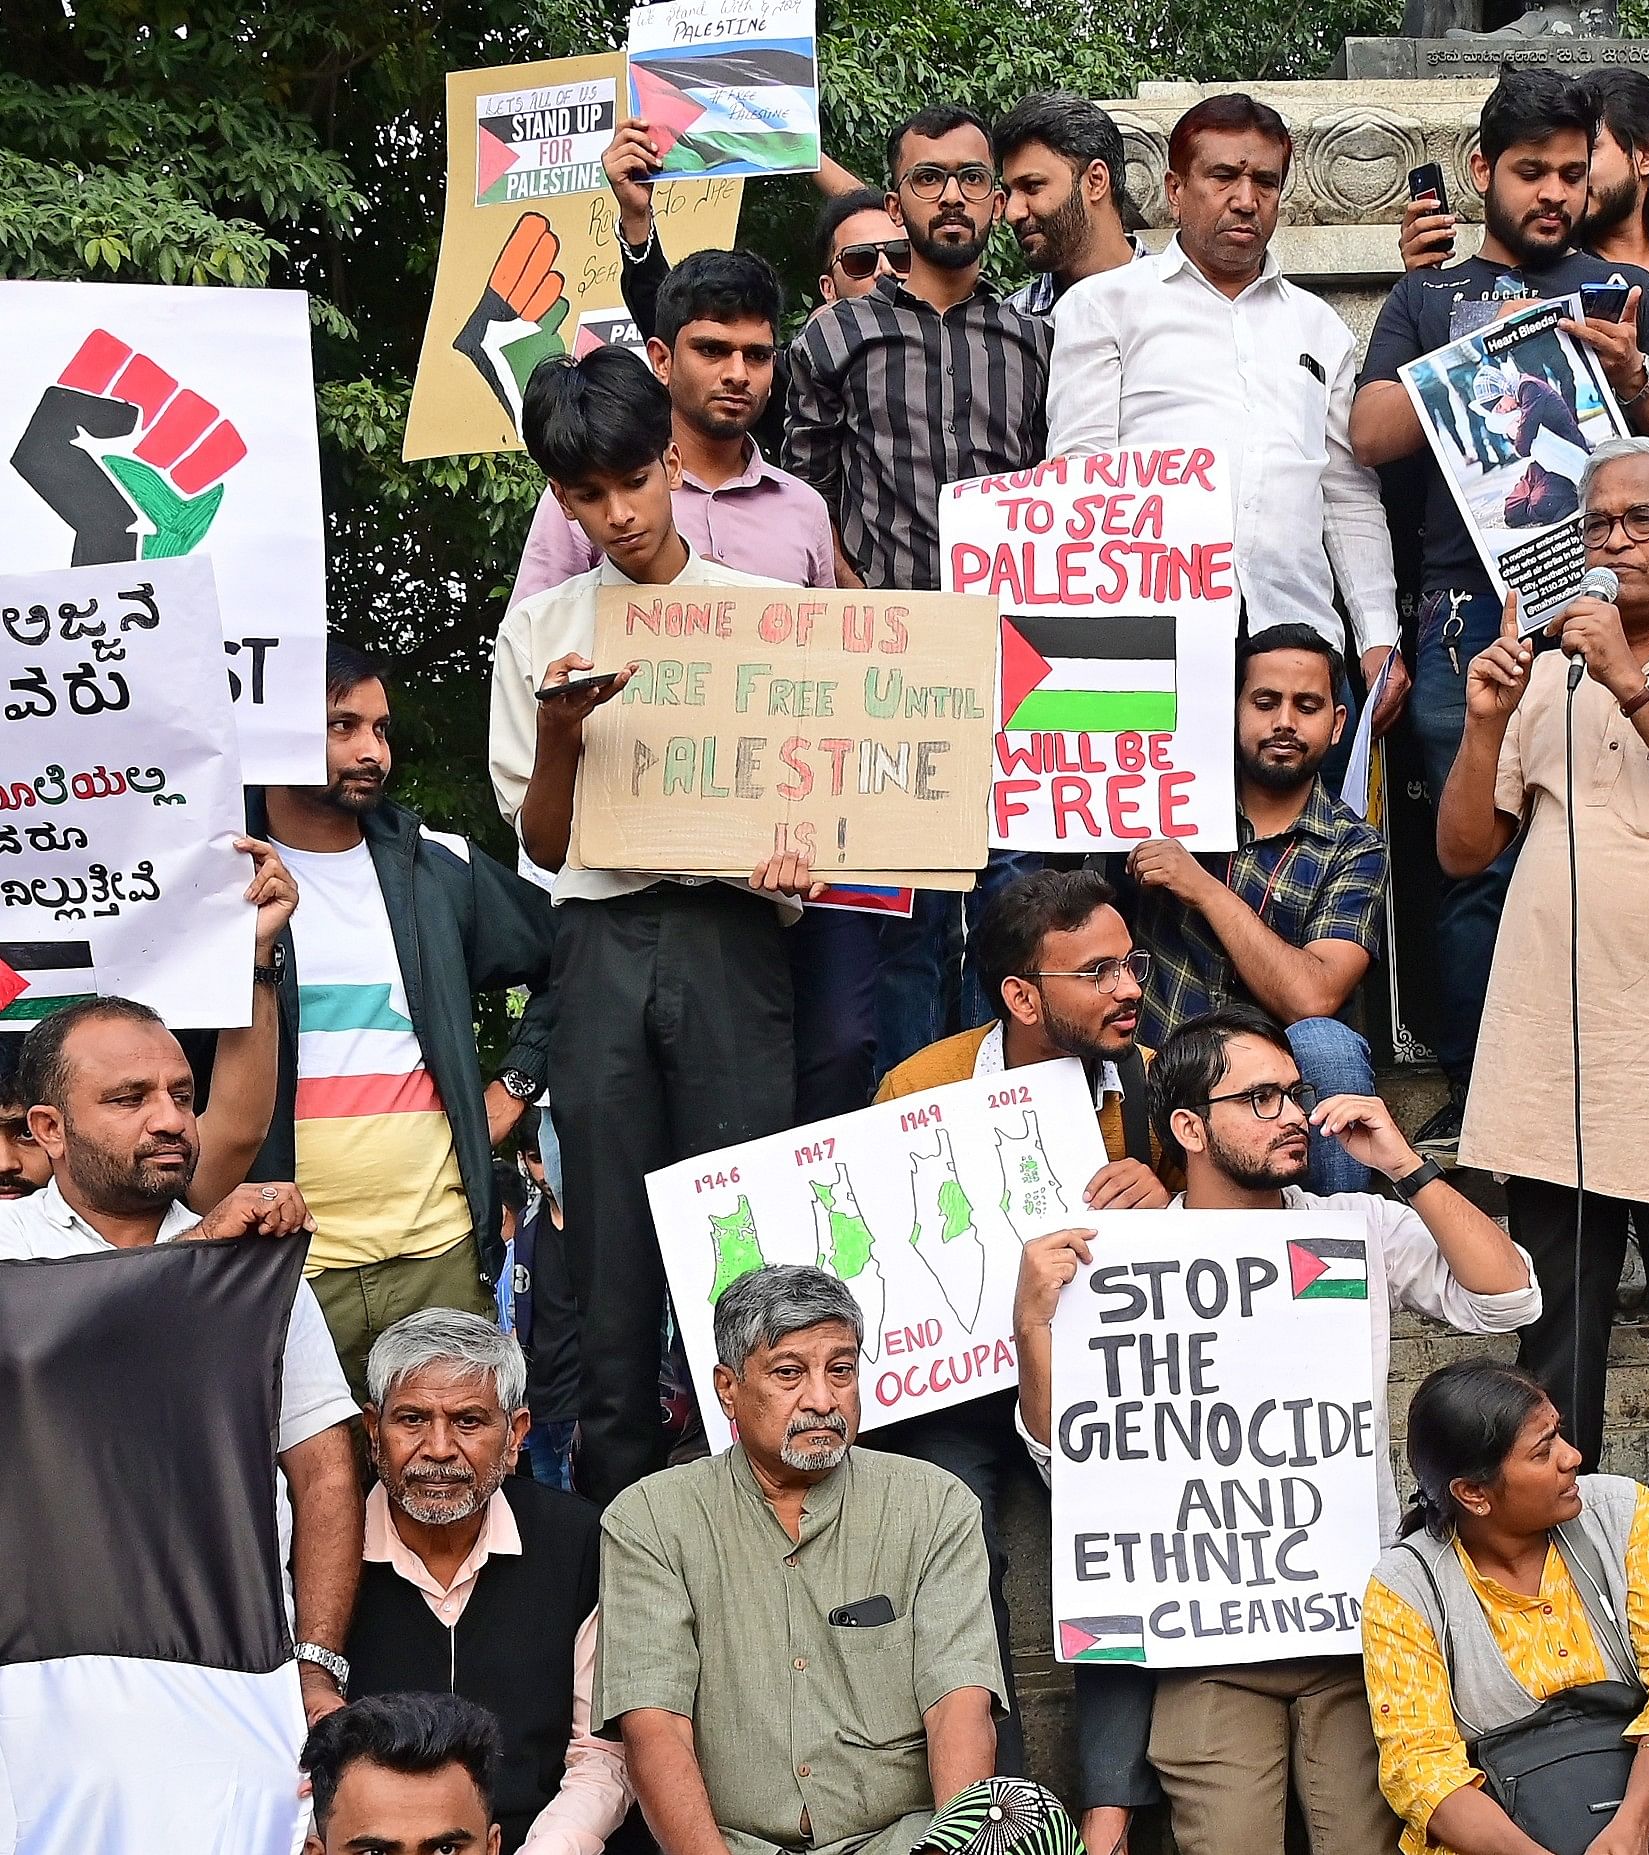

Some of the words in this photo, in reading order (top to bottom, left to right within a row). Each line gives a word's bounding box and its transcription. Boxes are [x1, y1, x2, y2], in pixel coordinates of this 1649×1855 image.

[673, 18, 767, 43] PALESTINE
[530, 91, 551, 110] ALL
[556, 89, 573, 105] OF
[579, 85, 597, 102] US
[727, 107, 789, 120] PALESTINE
[511, 108, 570, 142] STAND
[577, 104, 602, 133] UP
[539, 138, 573, 166] FOR
[506, 163, 601, 200] PALESTINE
[578, 255, 619, 298] SEA
[1487, 330, 1519, 353] Heart
[1518, 312, 1557, 338] Bleeds!
[953, 457, 1068, 499] FROM
[1084, 447, 1216, 492] RIVER
[995, 496, 1055, 535] TO
[1065, 494, 1164, 539] SEA
[1502, 557, 1509, 566] A
[1509, 545, 1535, 563] mother
[1536, 528, 1570, 549] embraces
[1502, 563, 1520, 577] child
[1521, 557, 1537, 568] who
[1537, 549, 1552, 561] was
[1551, 539, 1571, 553] killed
[1543, 556, 1563, 570] strike
[950, 541, 1234, 605] PALESTINE
[1538, 565, 1569, 584] southern
[625, 598, 737, 639] NONE
[757, 602, 828, 647] OF
[841, 604, 910, 654] US
[621, 658, 712, 706] ARE
[735, 663, 839, 718] FREE
[863, 666, 985, 720] UNTIL
[630, 735, 951, 801] PALESTINE
[994, 731, 1107, 776] WILL
[1115, 730, 1174, 772] BE
[993, 771, 1198, 840] FREE
[987, 1085, 1033, 1110] 2012
[899, 1104, 944, 1133] 1949
[794, 1137, 837, 1166] 1947
[694, 1166, 742, 1194] 1946
[1089, 1257, 1279, 1324] STOP
[884, 1318, 944, 1356] END
[1088, 1331, 1220, 1398] THE
[1058, 1397, 1374, 1468] GENOCIDE
[1176, 1476, 1322, 1532] AND
[1074, 1528, 1319, 1588] ETHNIC
